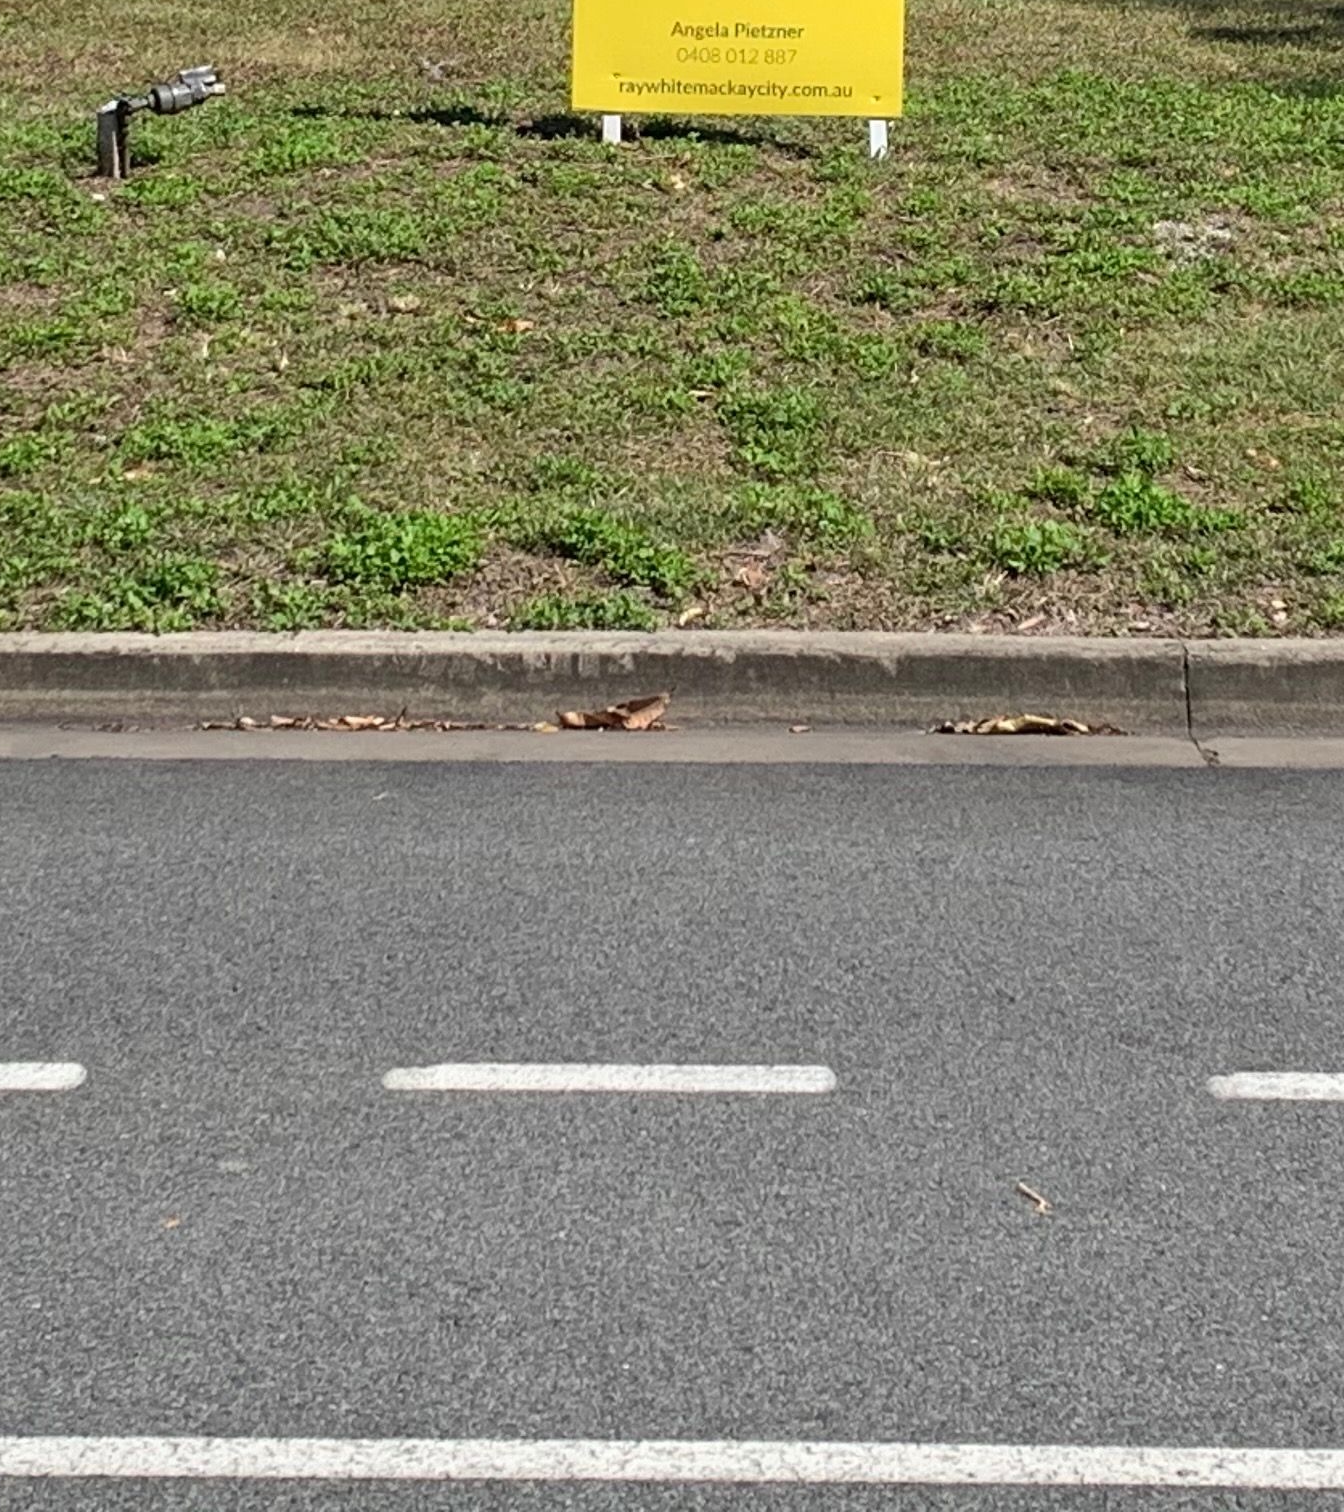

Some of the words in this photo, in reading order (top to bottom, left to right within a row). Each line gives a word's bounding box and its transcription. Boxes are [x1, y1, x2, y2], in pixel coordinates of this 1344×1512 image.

[670, 21, 729, 40] Angela
[735, 22, 805, 38] Pietzner
[676, 47, 721, 63] 0408
[726, 48, 759, 64] 012
[764, 48, 797, 65] 887
[619, 78, 853, 99] raywhitemackaycity.com.au
